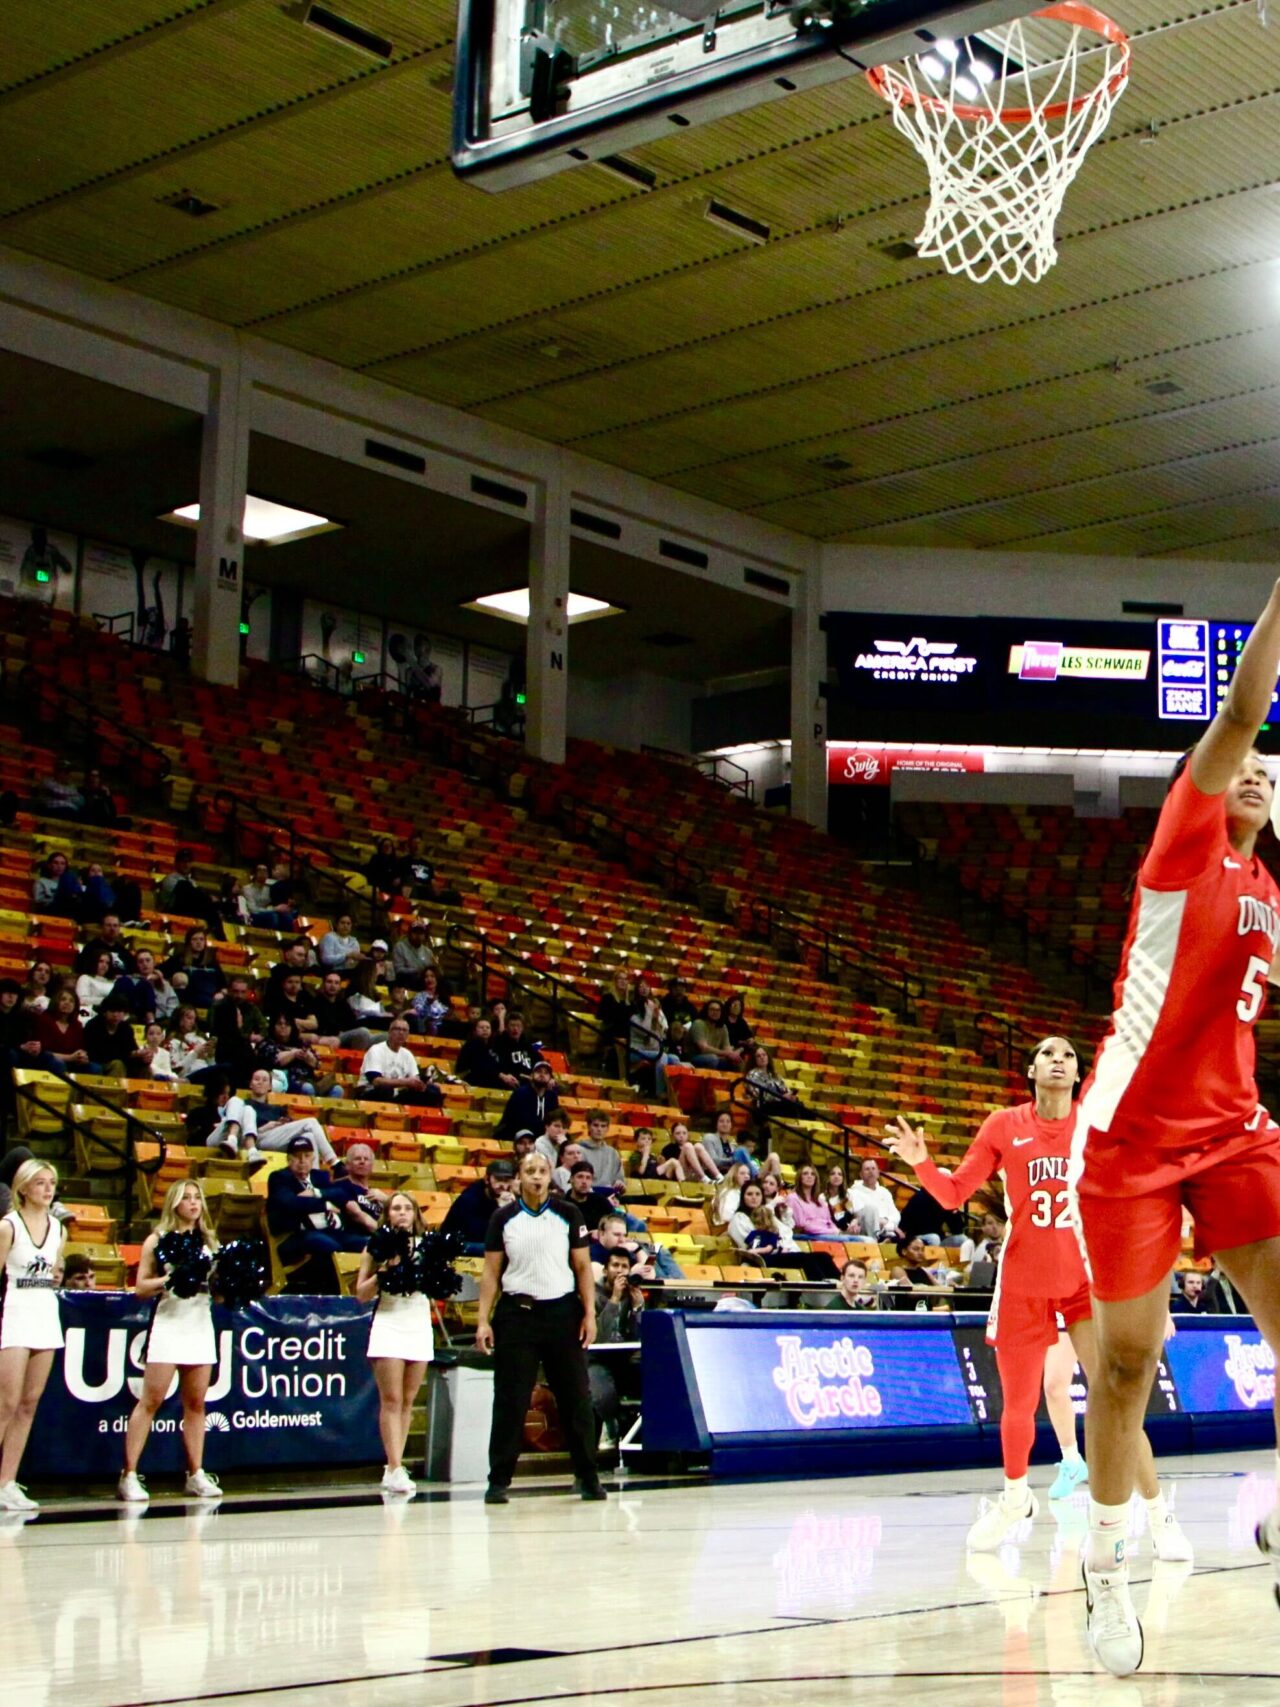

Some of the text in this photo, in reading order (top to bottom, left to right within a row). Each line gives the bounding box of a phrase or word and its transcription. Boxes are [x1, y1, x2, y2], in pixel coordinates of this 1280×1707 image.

[219, 557, 237, 580] M
[550, 652, 563, 671] N
[855, 654, 977, 672] AMERICA FIRST
[1061, 656, 1142, 671] LES SCHWAB
[813, 724, 823, 738] P
[844, 757, 880, 780] Swig
[1236, 955, 1270, 1023] 5
[1027, 1156, 1070, 1187] UNL
[1030, 1189, 1072, 1229] 32
[240, 1327, 346, 1361] Credit
[773, 1335, 874, 1391] Arctic
[242, 1365, 346, 1398] Union
[786, 1376, 882, 1426] Circle
[99, 1419, 108, 1432] a
[112, 1416, 176, 1432] diion
[233, 1410, 322, 1430] Goldenwest
